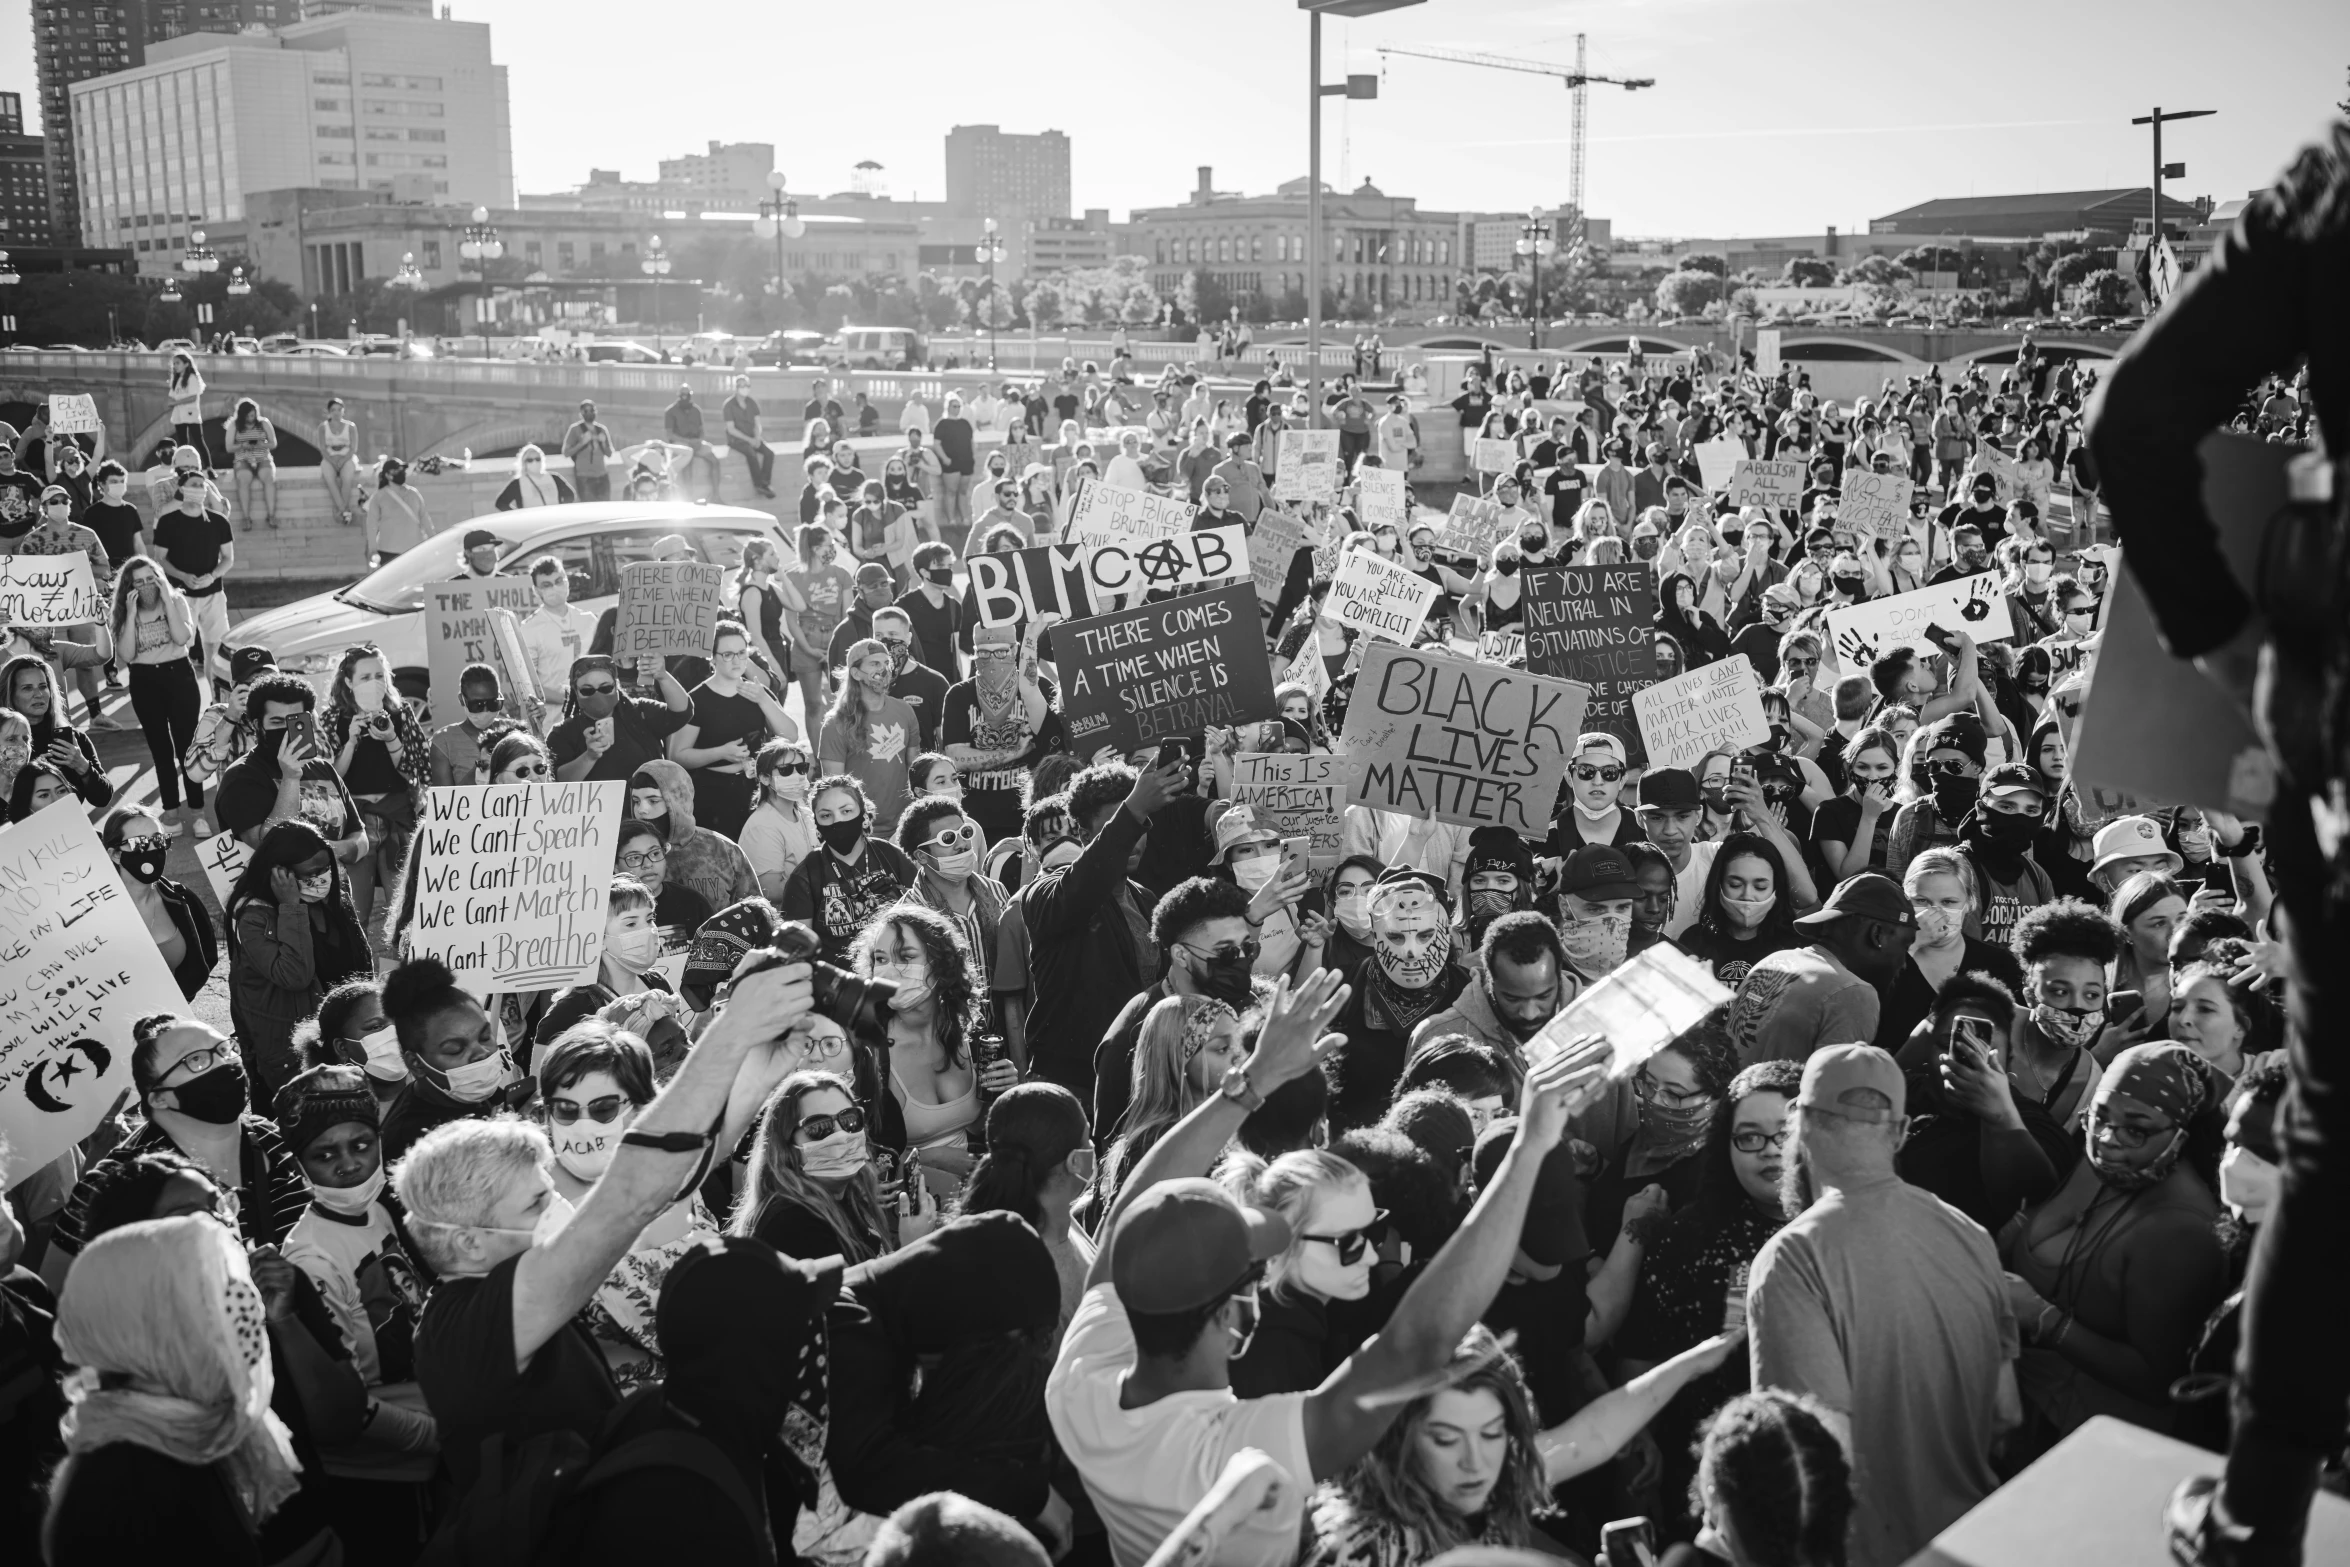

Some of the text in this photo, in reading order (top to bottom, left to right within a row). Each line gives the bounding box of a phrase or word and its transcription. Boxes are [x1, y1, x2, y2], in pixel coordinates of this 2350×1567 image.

[1364, 470, 1383, 482] YOUR
[1742, 463, 1797, 478] ABOLISH
[1754, 478, 1780, 490] ALL
[1846, 475, 1881, 494] NO
[1363, 482, 1397, 496] SILENCE
[1388, 496, 1396, 506] IS
[1740, 493, 1797, 508] POLICE
[1842, 489, 1895, 510] JUSTICE
[1098, 488, 1183, 527] STOP Police
[1840, 504, 1870, 520] NO
[1080, 530, 1110, 548] YOUR
[1110, 511, 1180, 538] BRUTALITY
[1447, 514, 1496, 541] LIVES
[0, 555, 75, 588] Law
[625, 565, 723, 588] THERE COMES
[1346, 555, 1407, 585] IF YOU ARE
[1527, 571, 1642, 596] IF YOU ARE
[436, 586, 539, 611] THE WHOLE
[626, 587, 665, 601] TIME
[670, 588, 713, 602] WHEN
[968, 544, 1099, 629] BLM
[1335, 580, 1384, 606] YOU ARE
[1379, 578, 1423, 605] SILENT
[2, 592, 104, 624] Morality
[625, 605, 711, 628] SILENCE
[1343, 600, 1412, 636] COMPLICIT
[1527, 596, 1632, 628] NEUTRAL IN
[1889, 604, 1936, 626] DONT
[442, 618, 486, 640] DAMN
[615, 629, 712, 653] IS BETRAYAL
[1075, 601, 1232, 656] THERE COMES
[1529, 626, 1655, 658] SITUATIONS OF
[463, 640, 485, 663] IS
[1476, 634, 1522, 657] JUSTIC
[1073, 668, 1092, 696] A
[1155, 635, 1221, 672] WHEN
[1548, 649, 1645, 680] INJUSTICE
[1377, 657, 1564, 754] BLACK
[1644, 691, 1665, 709] ALL
[1674, 677, 1703, 697] LIVES
[1135, 692, 1245, 741] BETRAYAL
[1612, 700, 1630, 717] OF
[1645, 685, 1746, 731] MATTER UNTIL
[1070, 712, 1109, 735] #BLM
[1650, 719, 1699, 751] BLACK
[1699, 703, 1741, 729] LIVES
[1406, 723, 1540, 777] LIVES
[1670, 722, 1752, 764] MATTER!!!
[1242, 756, 1292, 782] This
[432, 789, 470, 821] We
[540, 783, 603, 815] Walk
[1231, 785, 1334, 814] AMERICA!
[1360, 762, 1529, 829] MATTER
[1281, 812, 1339, 827] our Justice
[429, 828, 460, 856] We
[526, 815, 599, 855] Speak
[28, 834, 83, 870] KILL
[45, 863, 92, 895] YOU
[424, 864, 460, 893] We
[521, 855, 573, 896] Play
[55, 883, 119, 929] LIFE
[419, 899, 454, 930] We
[514, 875, 598, 921] March
[491, 913, 598, 973] Breathe
[25, 960, 64, 991] CAN
[31, 1004, 84, 1035] WILL
[86, 970, 131, 1002] LIVE
[562, 1137, 605, 1155] ACAB
